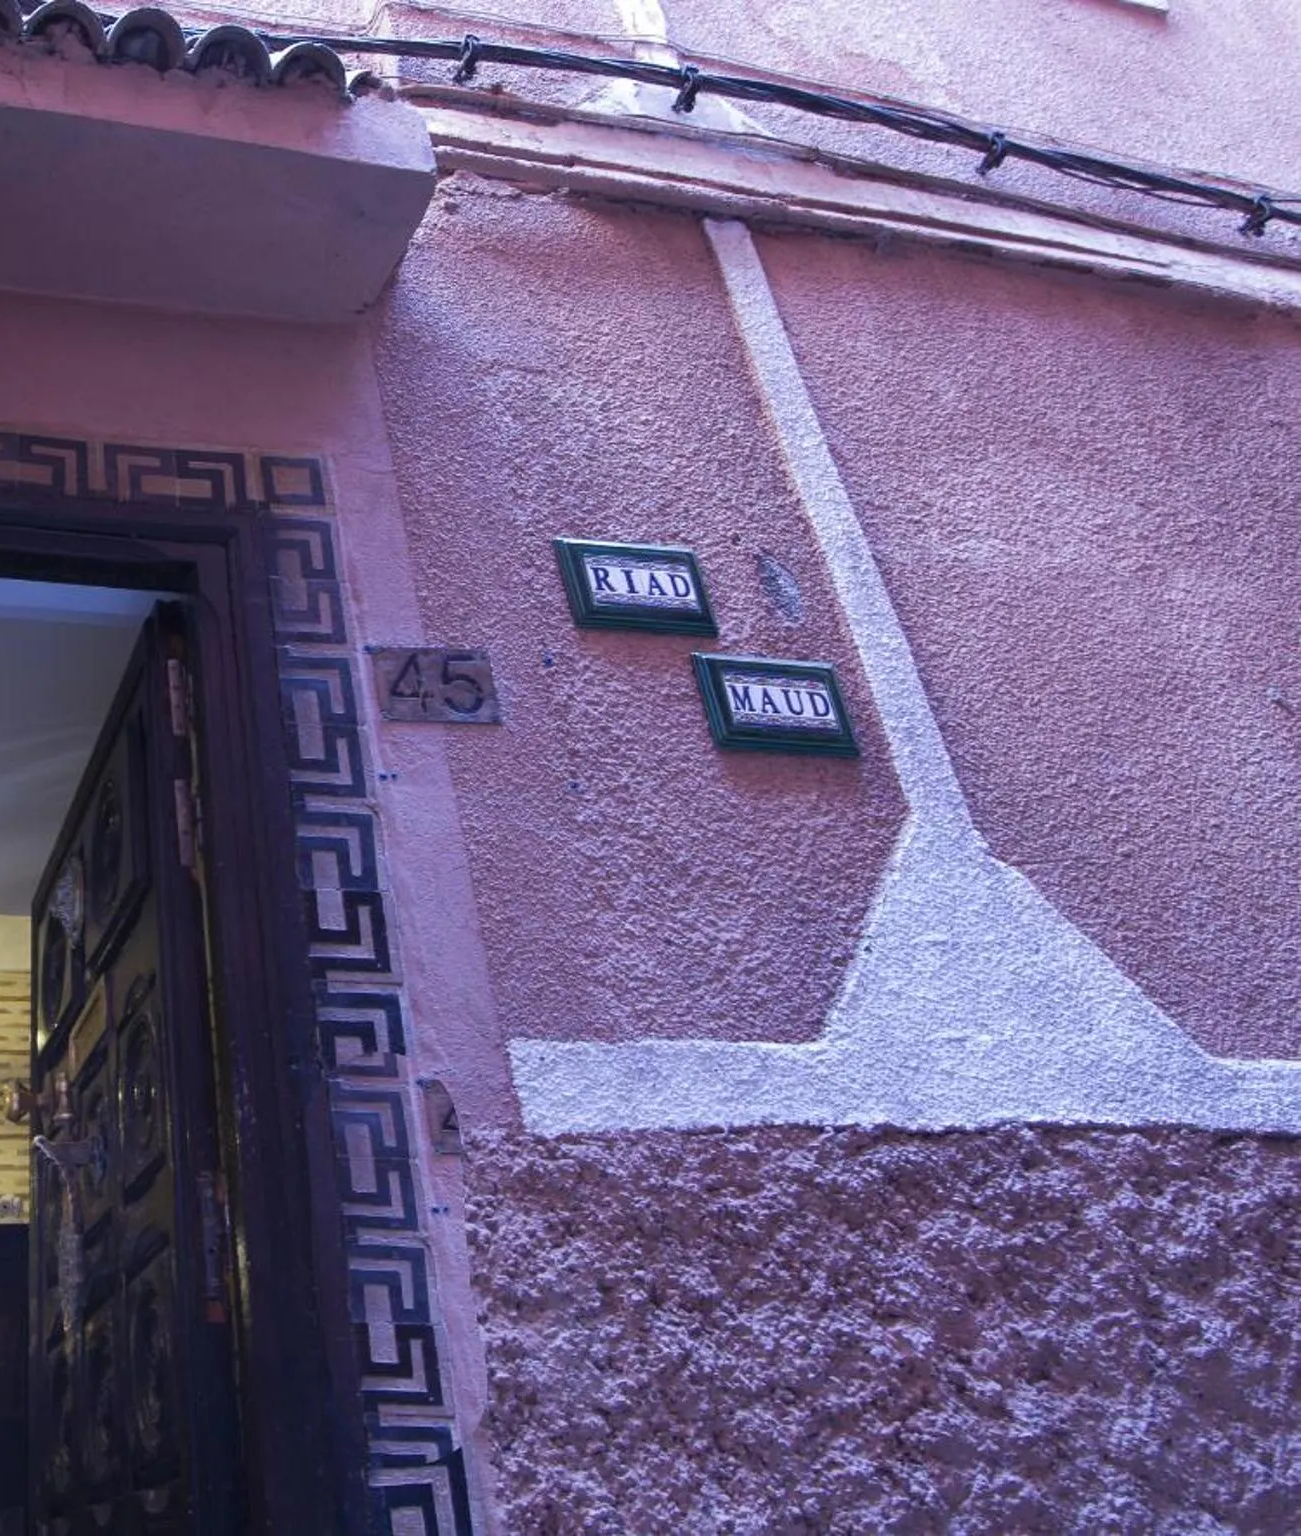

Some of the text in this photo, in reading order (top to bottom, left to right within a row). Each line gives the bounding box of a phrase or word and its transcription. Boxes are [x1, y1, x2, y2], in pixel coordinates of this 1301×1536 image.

[590, 566, 691, 598] RIAD
[389, 652, 484, 714] 45
[728, 685, 831, 717] MAUD
